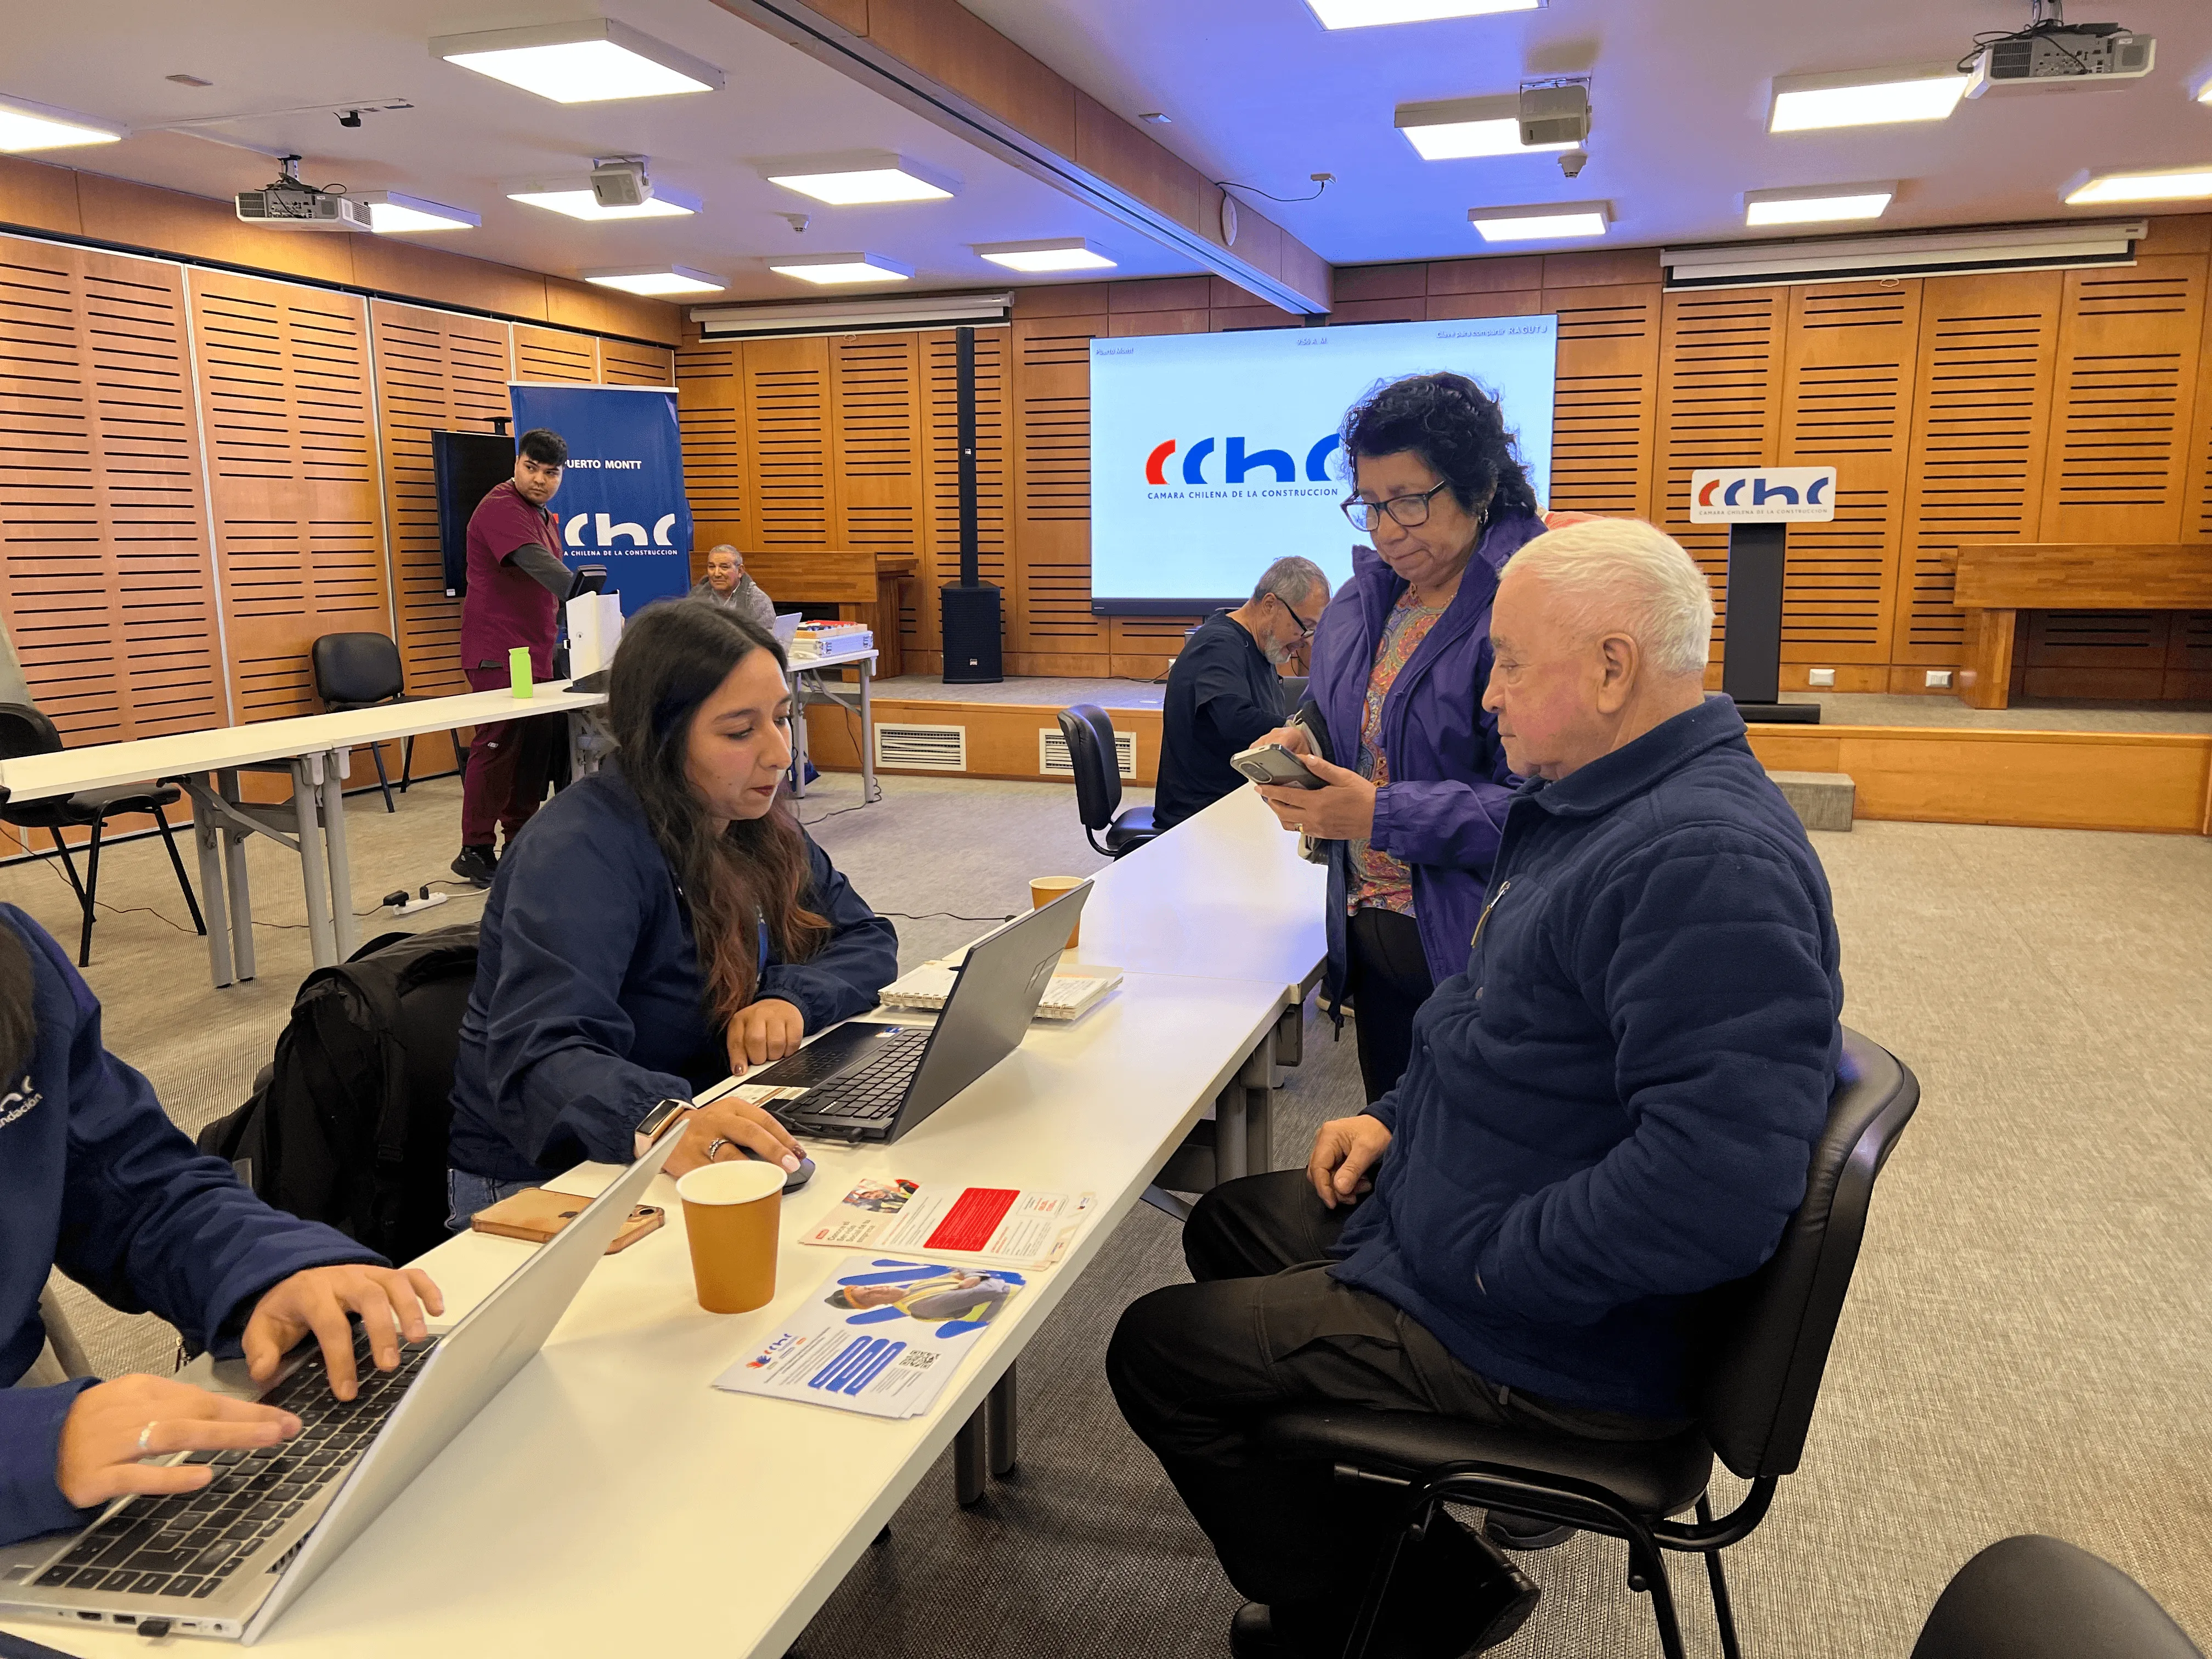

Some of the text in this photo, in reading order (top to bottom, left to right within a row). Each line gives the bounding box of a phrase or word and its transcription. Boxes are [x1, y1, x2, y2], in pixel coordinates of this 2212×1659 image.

[565, 459, 642, 470] UERTO MONTT
[1262, 488, 1338, 498] CONSTRUCCION
